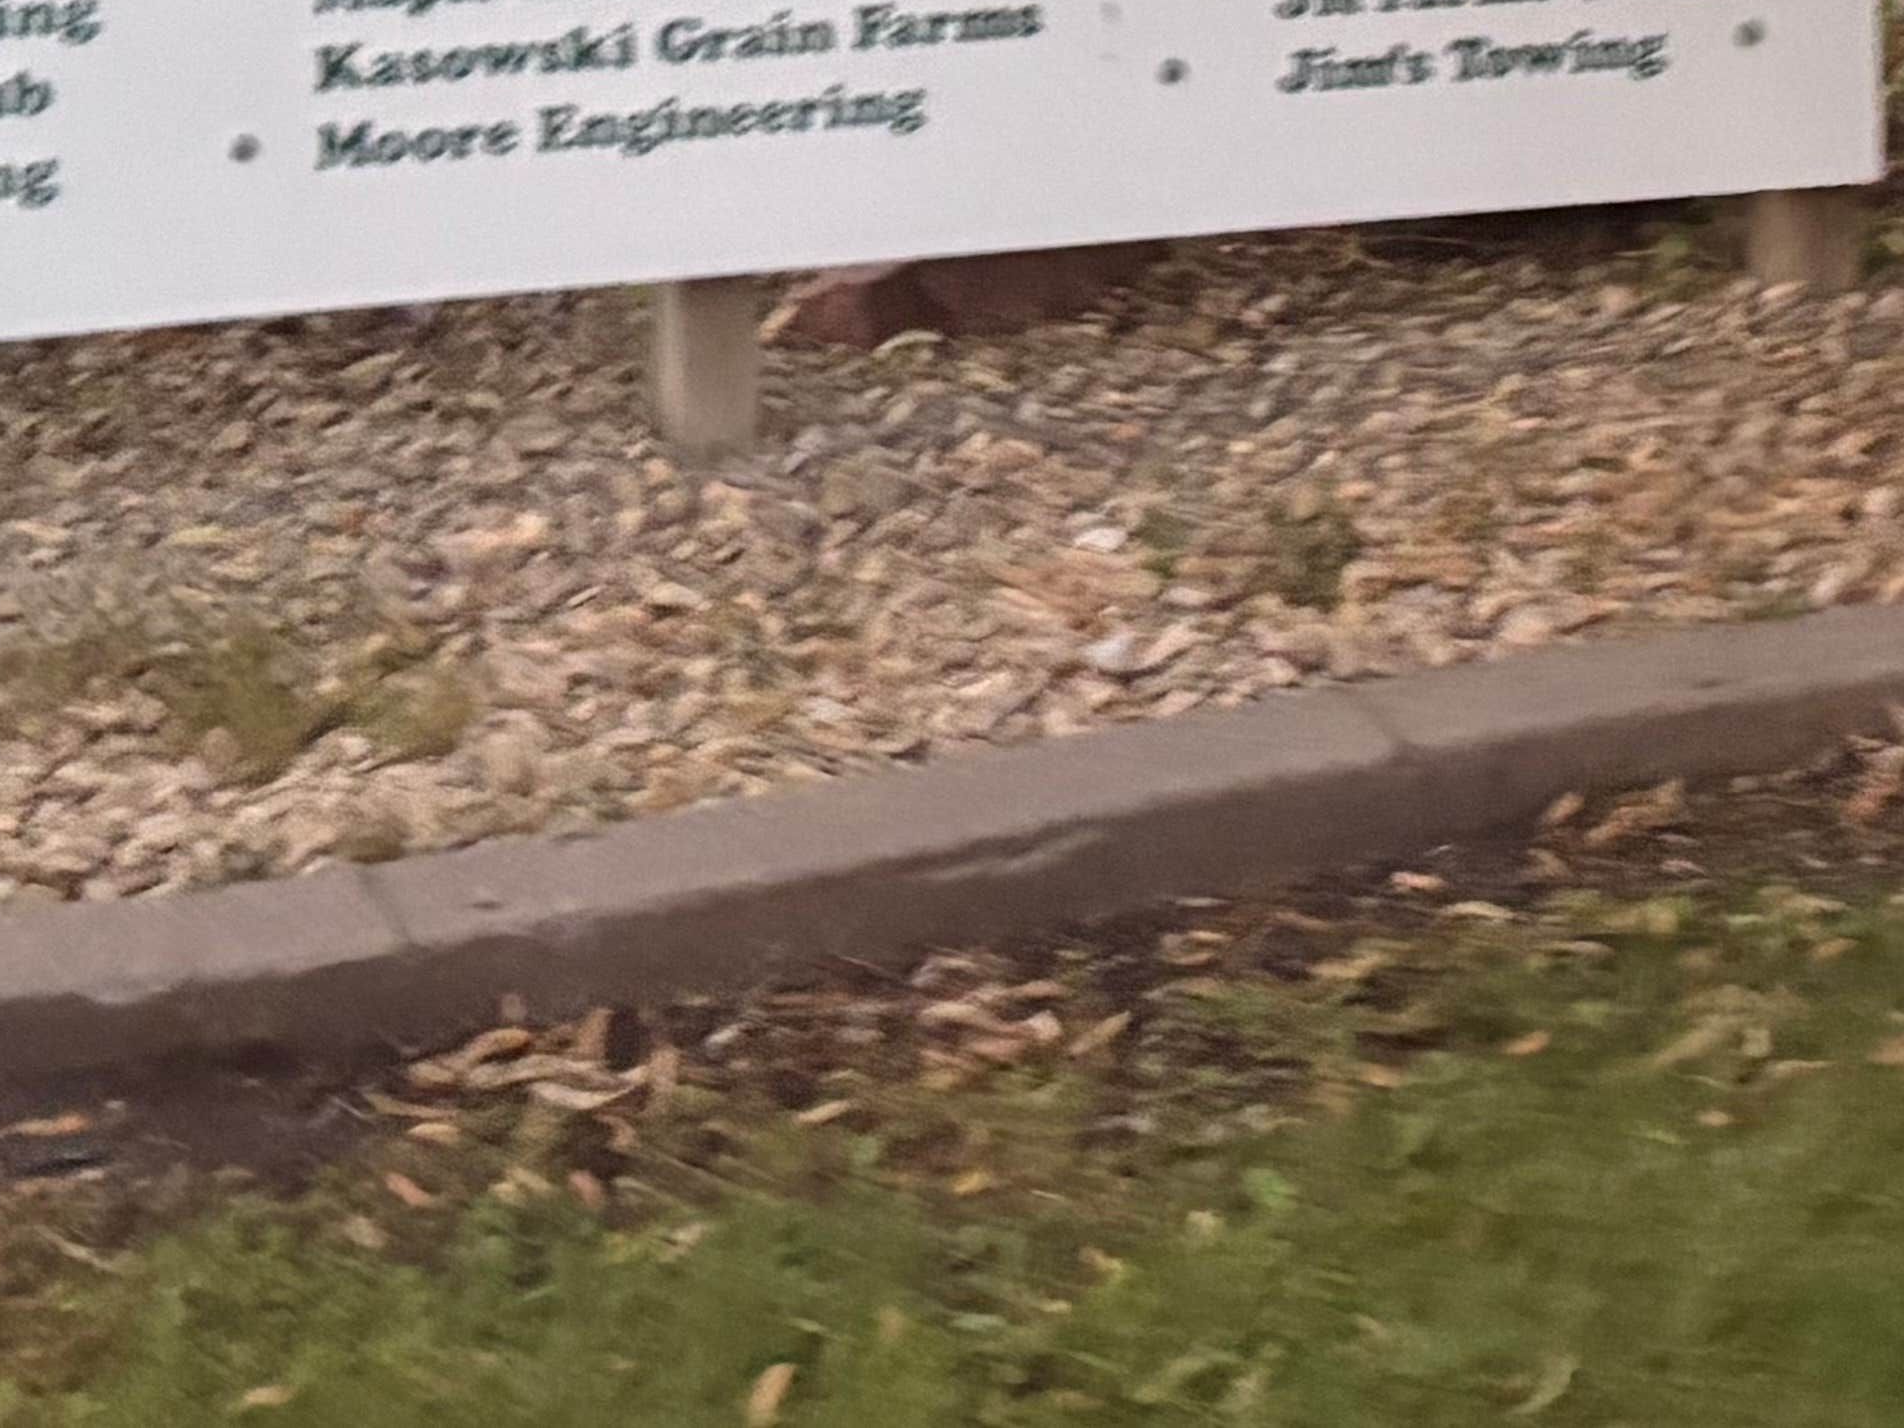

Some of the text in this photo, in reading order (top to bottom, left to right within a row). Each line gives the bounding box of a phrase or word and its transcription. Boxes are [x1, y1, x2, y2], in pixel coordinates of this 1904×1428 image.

[654, 12, 837, 67] Grain
[852, 2, 1044, 53] Farms
[1446, 28, 1671, 82] Towing
[315, 84, 929, 170] Moore Engineering
